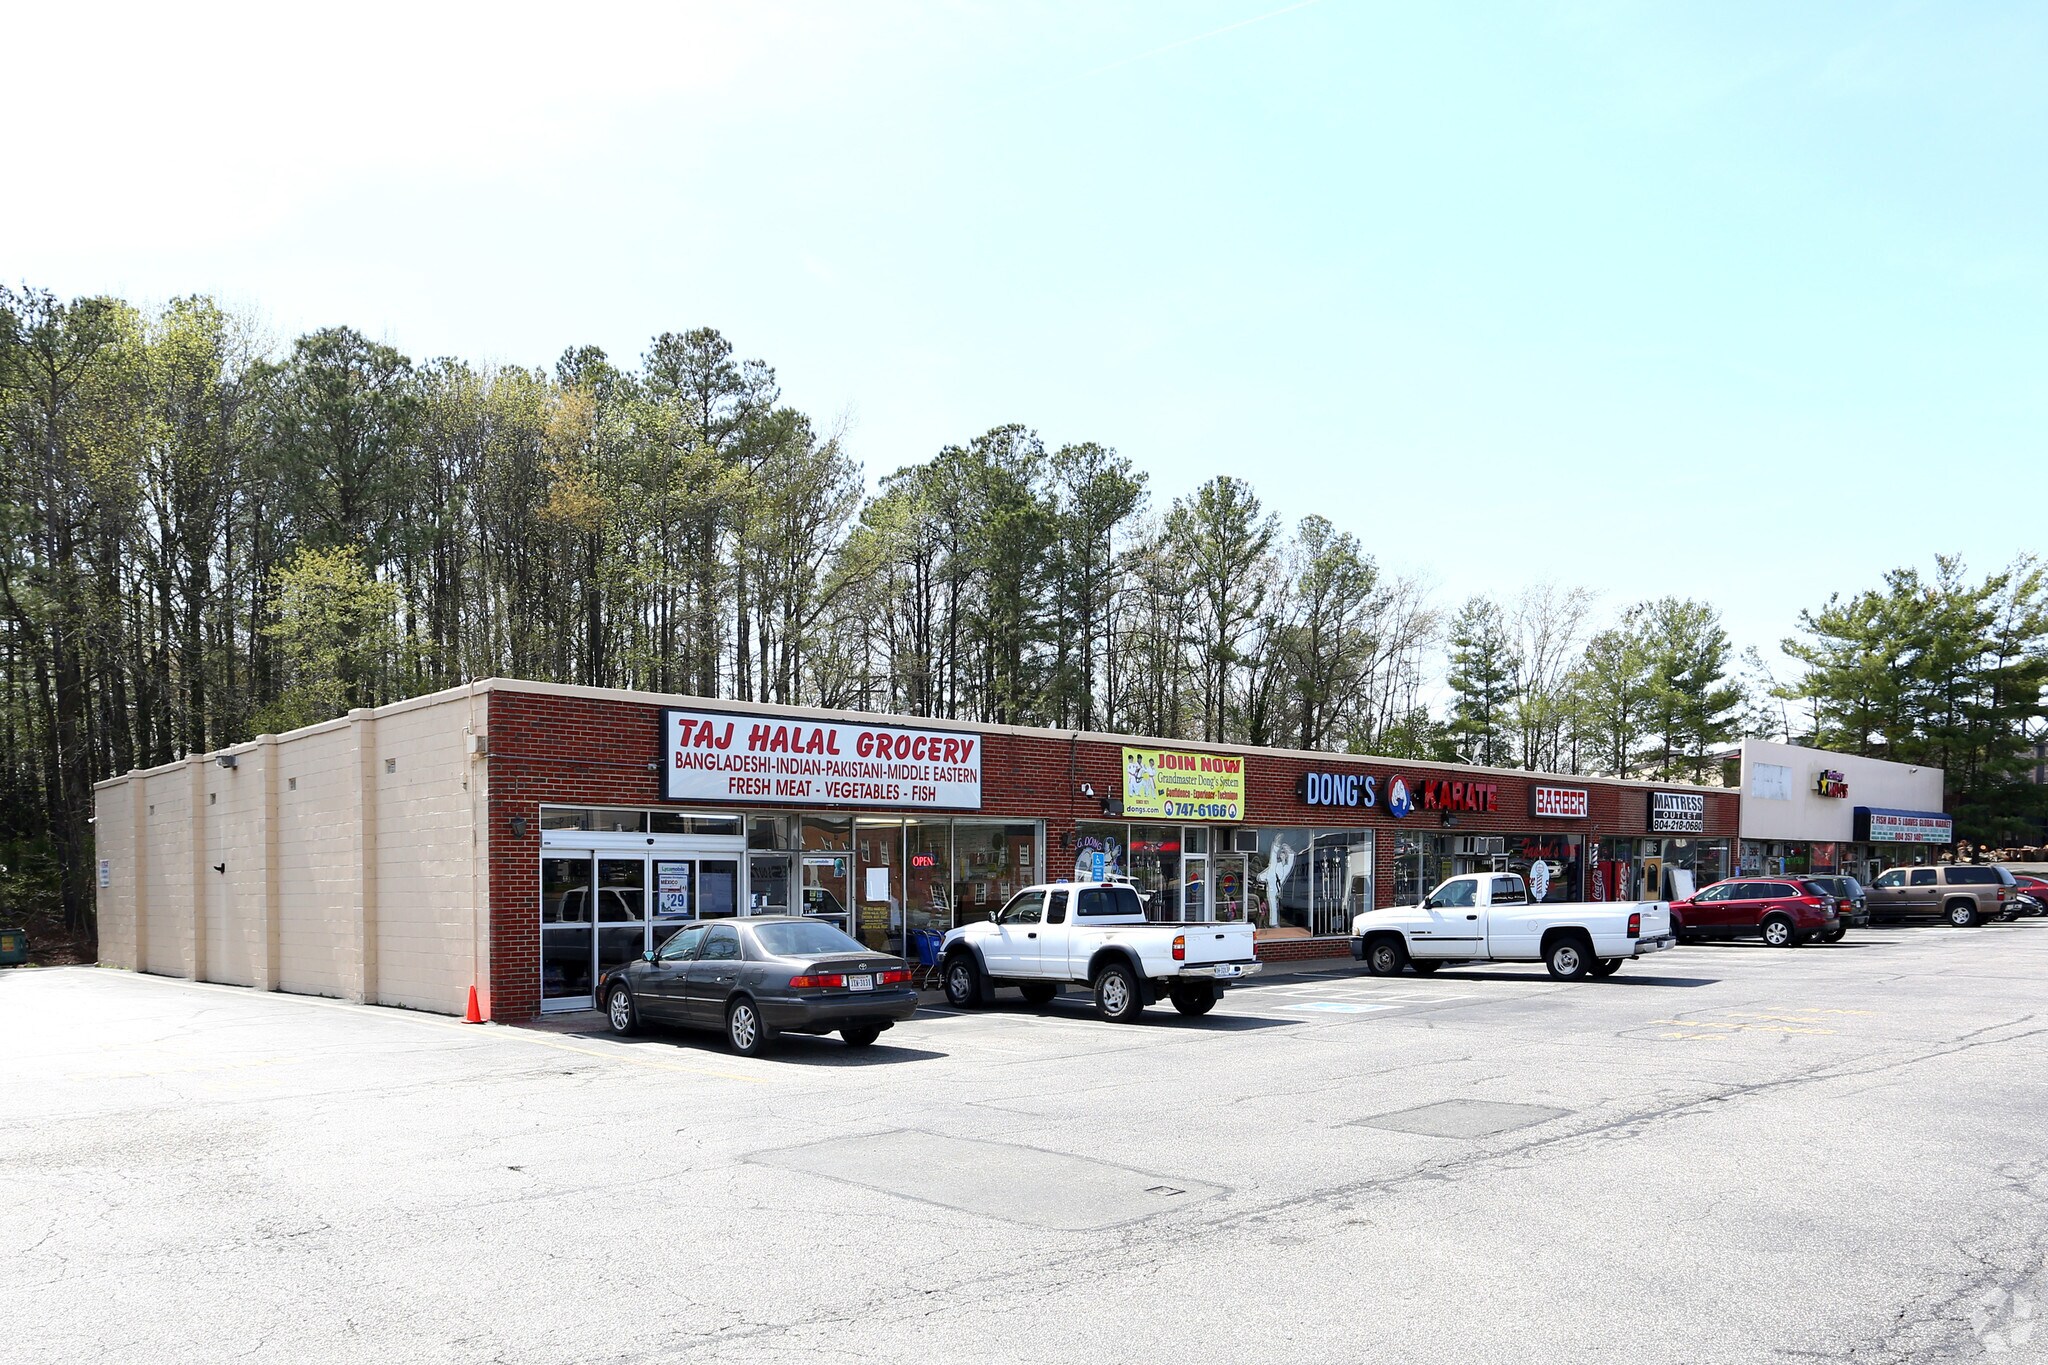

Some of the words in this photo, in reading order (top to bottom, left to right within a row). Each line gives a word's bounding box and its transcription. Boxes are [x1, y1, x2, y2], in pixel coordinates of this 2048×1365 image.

[678, 719, 734, 749] TAJ
[748, 724, 840, 755] HALAL
[856, 731, 974, 764] GROCERY
[1157, 753, 1196, 771] JOIN
[1200, 757, 1241, 773] NOW
[933, 766, 977, 783] EASTERN
[1157, 771, 1196, 786] Grandmaster
[1198, 774, 1219, 789] Dong's
[1219, 776, 1239, 790] System
[728, 776, 771, 795] FRESH
[775, 778, 811, 797] MEAT
[825, 781, 900, 801] VEGETABLES
[911, 785, 936, 802] FISH
[1306, 772, 1376, 808] DONG'S
[1423, 779, 1498, 812] KARATE
[1126, 805, 1159, 814] dongs.com
[1175, 802, 1227, 817] 747-6166
[1537, 789, 1587, 815] BARBER
[1654, 793, 1703, 812] MATTRESS
[1662, 811, 1697, 820] OUTLET
[1871, 815, 1875, 824] 2
[1876, 816, 1887, 825] FISH
[1887, 817, 1897, 825] AND
[912, 855, 934, 867] OPEN
[666, 893, 685, 907] $29
